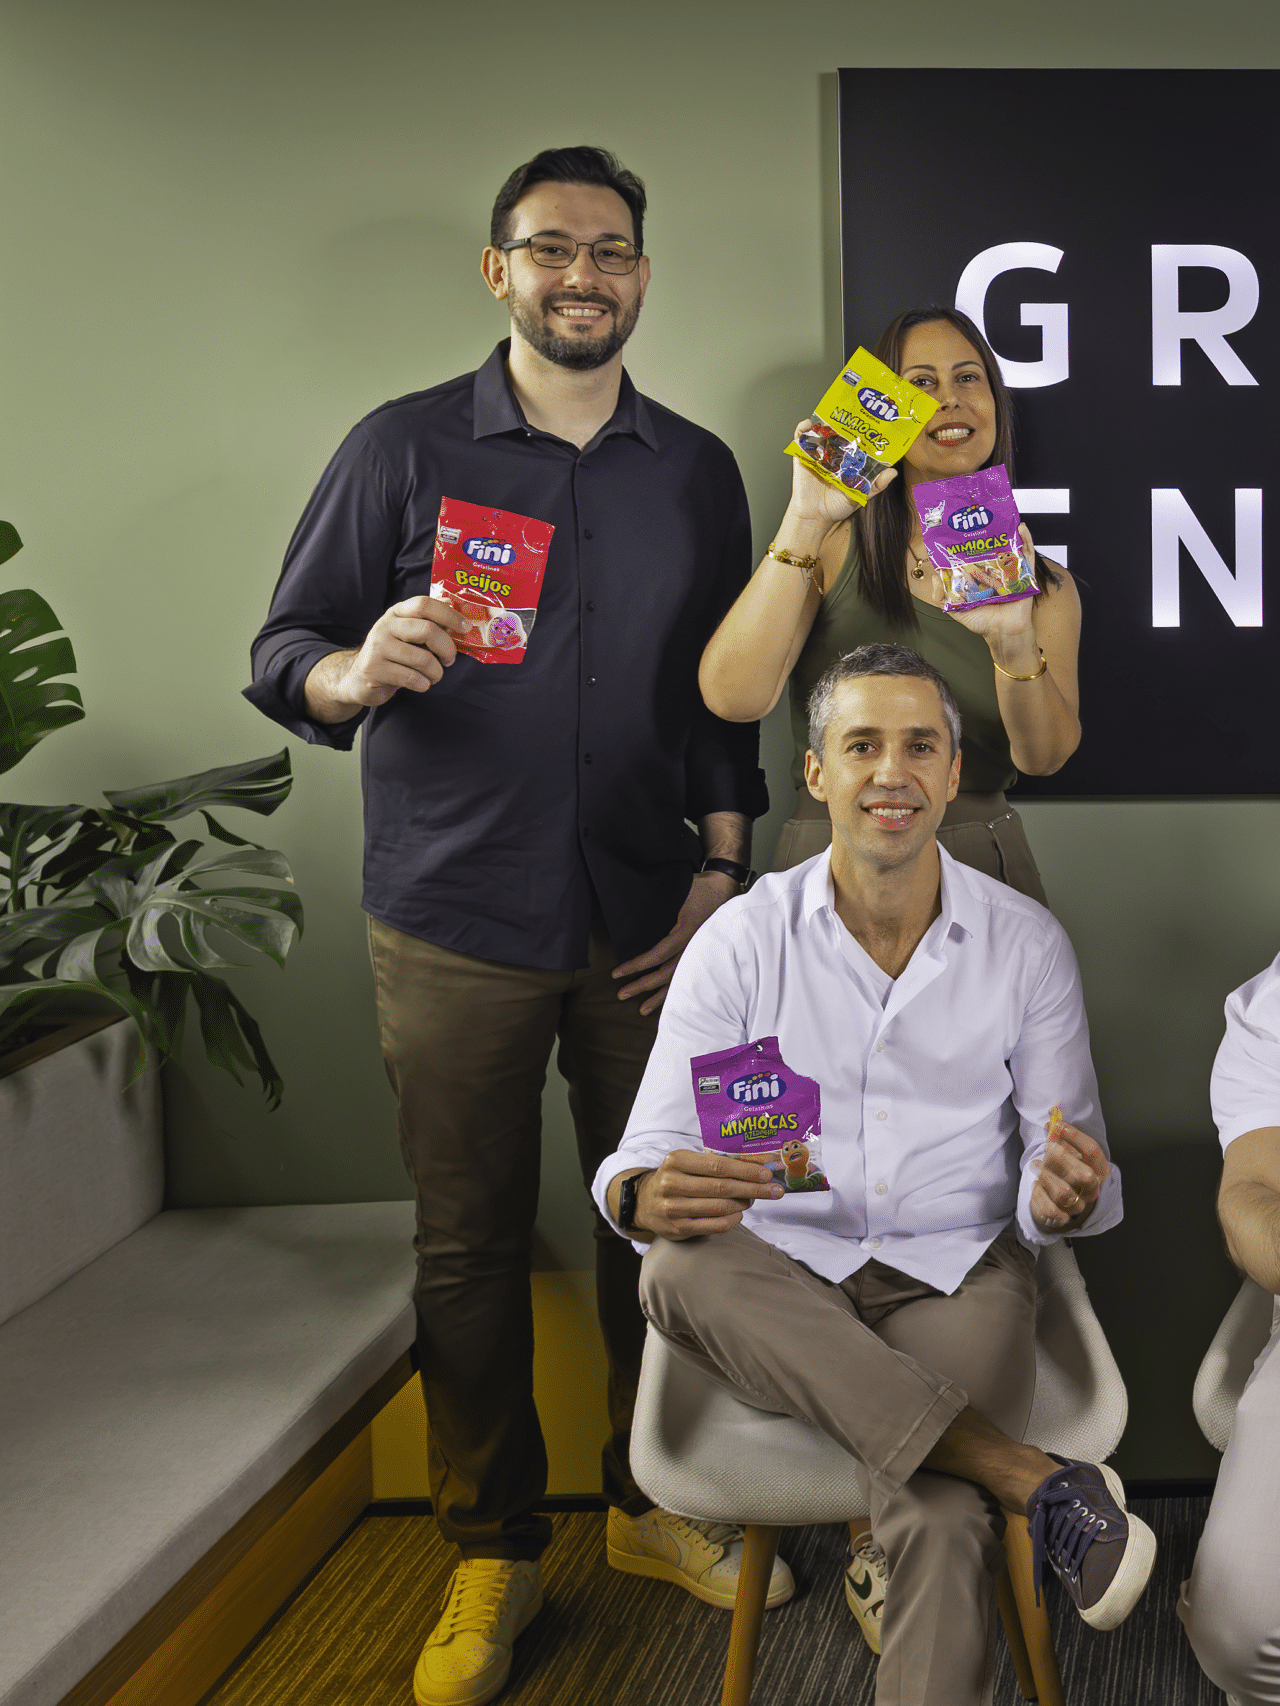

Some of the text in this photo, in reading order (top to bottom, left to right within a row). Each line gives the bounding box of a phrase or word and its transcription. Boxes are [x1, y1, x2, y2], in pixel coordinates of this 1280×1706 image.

[859, 389, 899, 421] Fini
[830, 407, 889, 451] MINHOCAS
[952, 506, 989, 530] Fini
[467, 540, 513, 565] Fini
[946, 533, 1009, 556] MINHOCAS
[454, 570, 513, 598] Beijos
[733, 1073, 779, 1102] Fini
[720, 1112, 799, 1138] MINHOCAS
